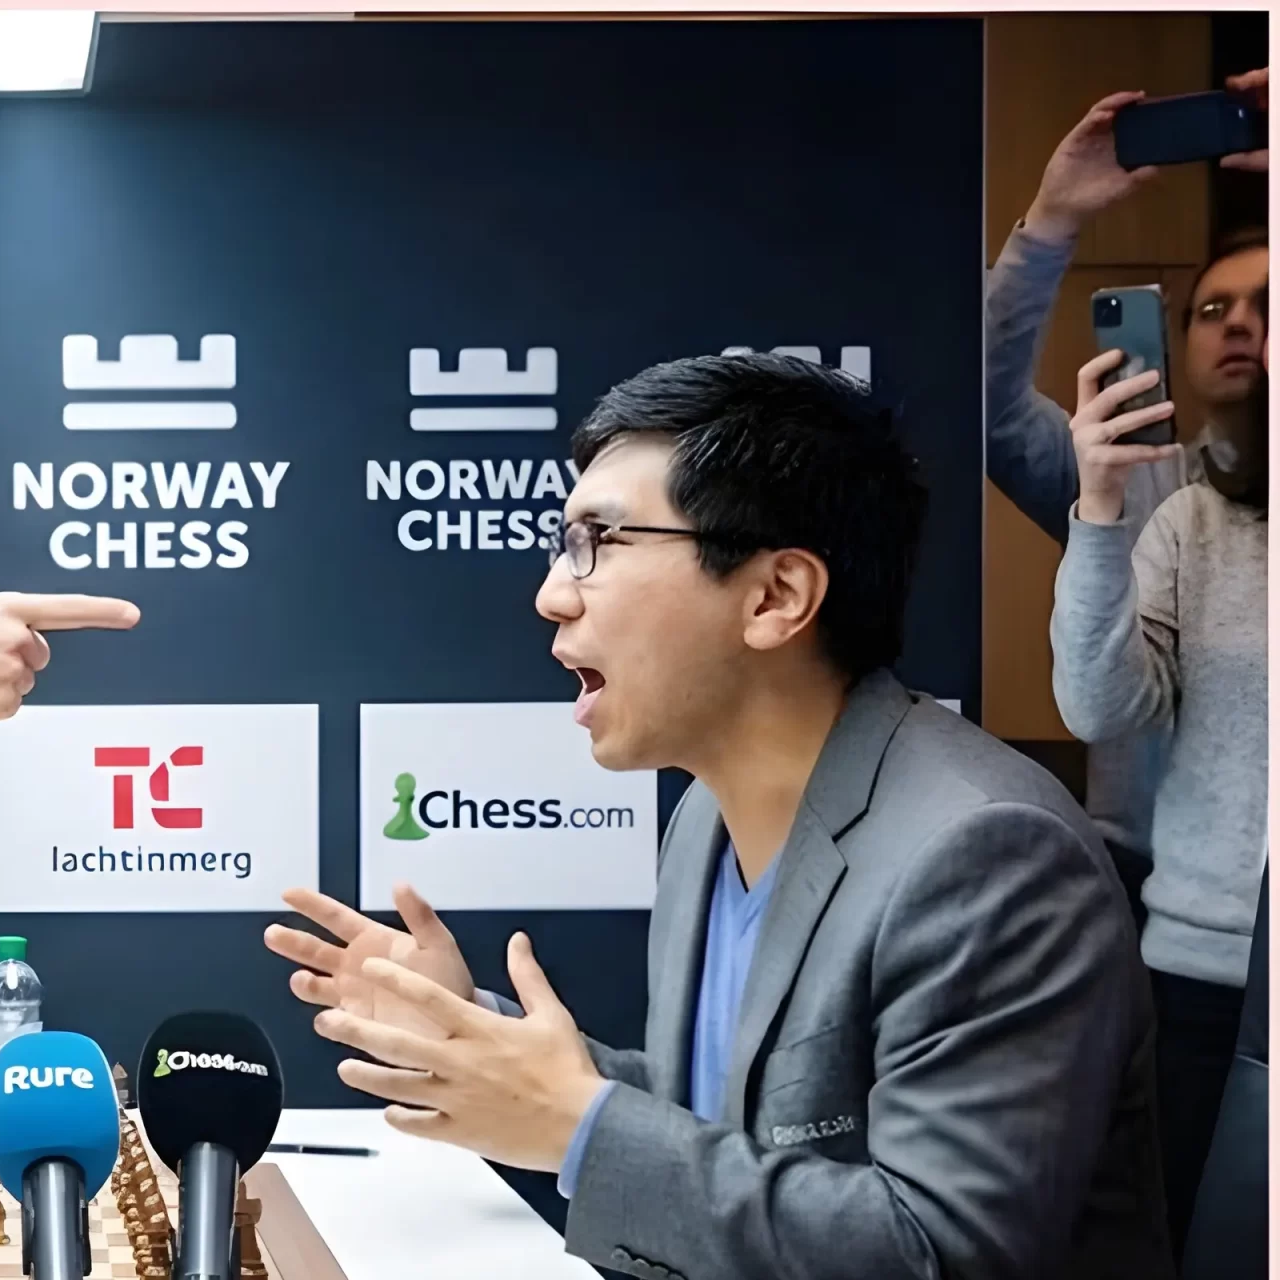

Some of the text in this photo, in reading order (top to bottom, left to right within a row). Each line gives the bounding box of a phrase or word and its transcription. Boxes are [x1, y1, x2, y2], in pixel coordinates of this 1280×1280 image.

[12, 461, 290, 509] NORWAY
[49, 520, 249, 569] CHESS
[397, 509, 563, 550] CHESS
[418, 789, 634, 829] Chess.com
[52, 846, 252, 879] lachtinmerg
[4, 1065, 94, 1094] Rure
